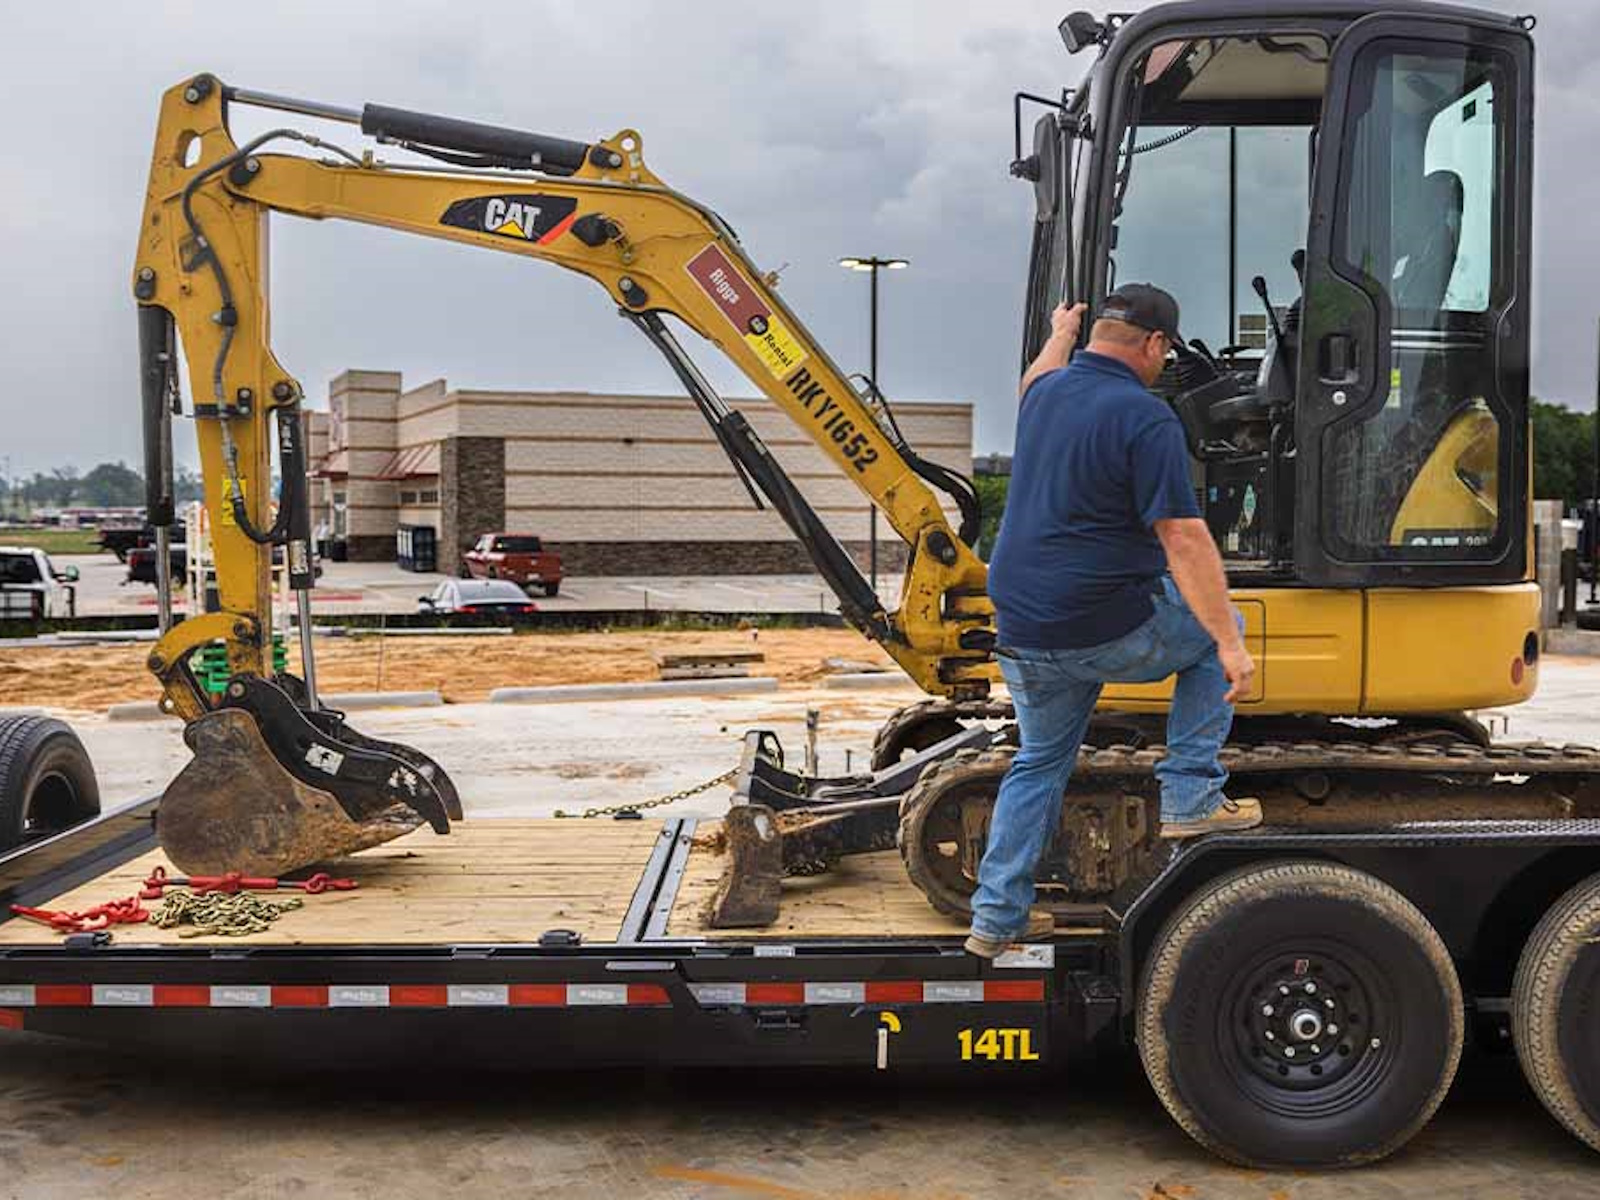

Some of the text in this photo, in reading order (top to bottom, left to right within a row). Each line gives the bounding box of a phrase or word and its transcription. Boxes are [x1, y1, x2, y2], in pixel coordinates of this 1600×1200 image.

[484, 198, 542, 240] CAT
[709, 267, 740, 305] Riggs
[764, 333, 793, 368] Rental
[786, 366, 878, 474] RKY1652
[958, 1028, 1039, 1060] 14TL
